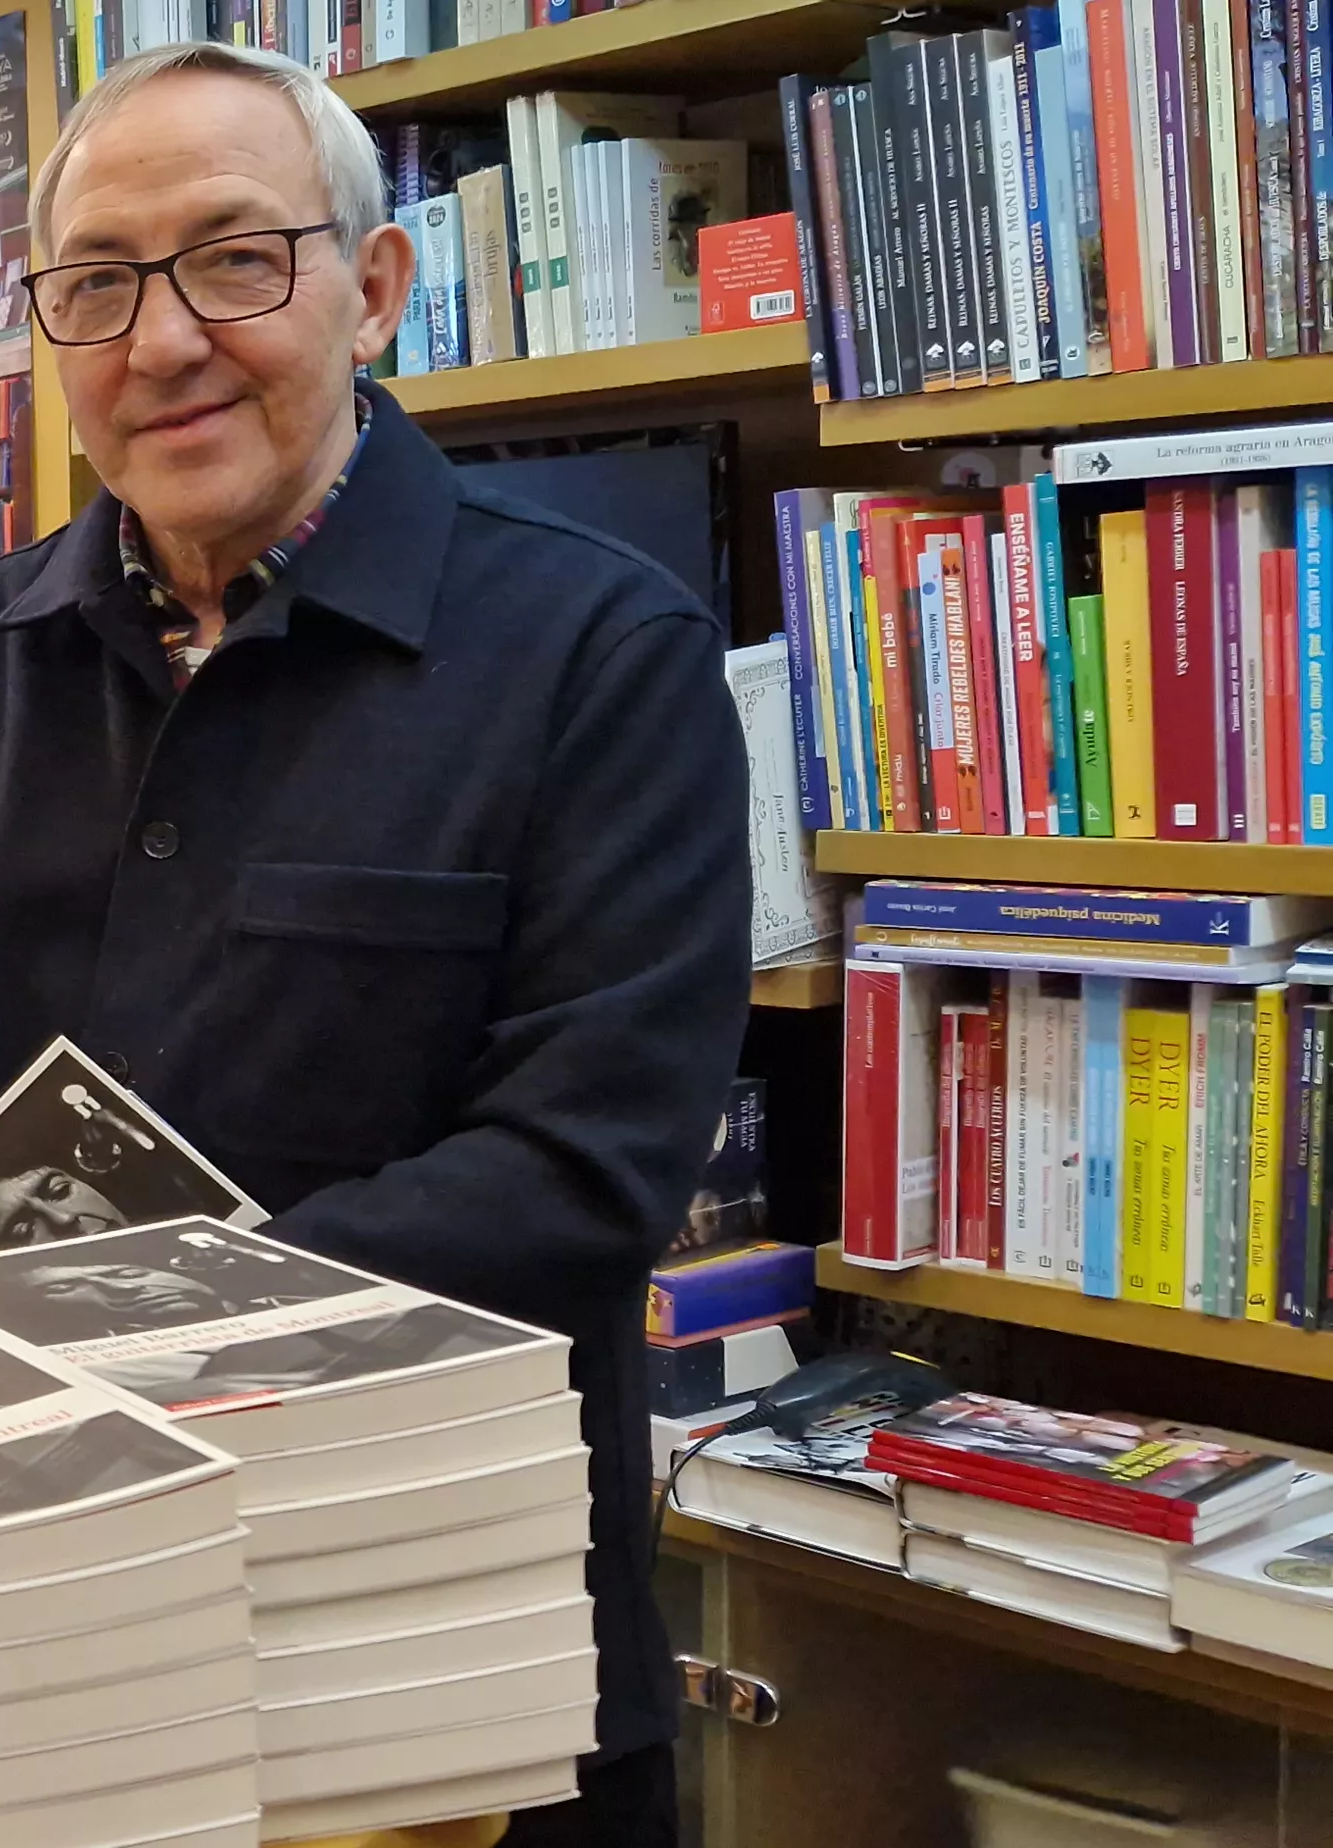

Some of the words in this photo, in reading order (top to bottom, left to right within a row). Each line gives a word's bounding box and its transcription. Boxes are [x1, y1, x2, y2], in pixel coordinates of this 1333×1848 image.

[1020, 98, 1032, 132] muerte
[790, 134, 800, 152] LUIS
[884, 128, 894, 161] HUESCA
[1024, 132, 1032, 143] su
[1024, 144, 1034, 157] de
[648, 178, 659, 194] de
[1000, 140, 1020, 232] MONTESCOS
[1024, 158, 1039, 210] Centenario
[649, 200, 661, 246] corridas
[918, 213, 929, 252] SEÑORAS
[950, 209, 961, 248] SEÑORAS
[981, 206, 992, 247] SEÑORAS
[921, 252, 930, 260] Y
[953, 249, 962, 257] Y
[984, 248, 994, 256] Y
[1009, 239, 1022, 250] Y
[1030, 221, 1045, 263] COSTA
[1221, 225, 1234, 288] CUCARACHA
[652, 252, 662, 271] Las
[833, 260, 841, 270] de
[895, 256, 906, 288] Manuel
[923, 258, 934, 293] DAMAS
[955, 255, 965, 290] DAMAS
[986, 255, 996, 287] DAMAS
[1011, 257, 1030, 349] CAPULETOS
[1033, 265, 1051, 324] JOAQUÍN
[1157, 447, 1172, 458] La
[1175, 443, 1222, 457] reforma
[1225, 441, 1272, 454] agraria
[1274, 440, 1290, 449] en
[782, 505, 793, 551] MAESTRA
[1173, 491, 1184, 531] SANDRA
[785, 551, 793, 564] MI
[1010, 513, 1032, 603] ENSÉÑAME
[1044, 542, 1056, 586] GABRIEL
[1174, 532, 1185, 571] FERRER
[786, 566, 796, 590] CON
[1017, 607, 1030, 620] A
[1175, 580, 1186, 623] LEONAS
[788, 592, 803, 680] CONVERSACIONES
[881, 613, 896, 648] bebé
[929, 613, 939, 650] Miriam
[1017, 622, 1033, 662] LEER
[1176, 624, 1186, 637] DE
[883, 649, 898, 668] mi
[933, 651, 942, 684] Tirado
[948, 640, 970, 700] REBELDES
[1176, 638, 1189, 677] ESPAÑA
[794, 694, 806, 738] L'ECUYER
[955, 701, 974, 766] MUJERES
[798, 740, 809, 791] CATHERINE
[772, 794, 784, 826] Jane
[1000, 905, 1090, 923] psiquedélica
[1092, 909, 1161, 926] Medicina
[1258, 1011, 1272, 1027] EL
[1196, 1033, 1207, 1073] FROMM
[1257, 1033, 1272, 1084] PODER
[1301, 1051, 1312, 1083] Ramiro
[1313, 1055, 1324, 1085] Ramiro
[1129, 1037, 1151, 1106] DYER
[1159, 1041, 1181, 1112] DYER
[1195, 1077, 1205, 1109] ERICH
[1256, 1089, 1270, 1117] DEL
[990, 1085, 1004, 1139] ACUERDOS
[989, 1140, 1003, 1189] CUATRO
[1133, 1138, 1148, 1157] Tus
[1162, 1144, 1176, 1162] Tus
[1194, 1151, 1202, 1162] DE
[1254, 1124, 1269, 1180] AHORA
[1019, 1161, 1026, 1170] DE
[988, 1191, 1003, 1206] LOS
[1017, 1197, 1026, 1217] FÁCIL
[1194, 1187, 1201, 1196] EL
[1252, 1198, 1266, 1238] Eckhart
[1251, 1242, 1265, 1267] Tolle
[243, 1324, 274, 1339] de
[279, 1300, 398, 1332] Montreal
[48, 1337, 130, 1358] Miguel
[141, 1320, 247, 1344] Barrero
